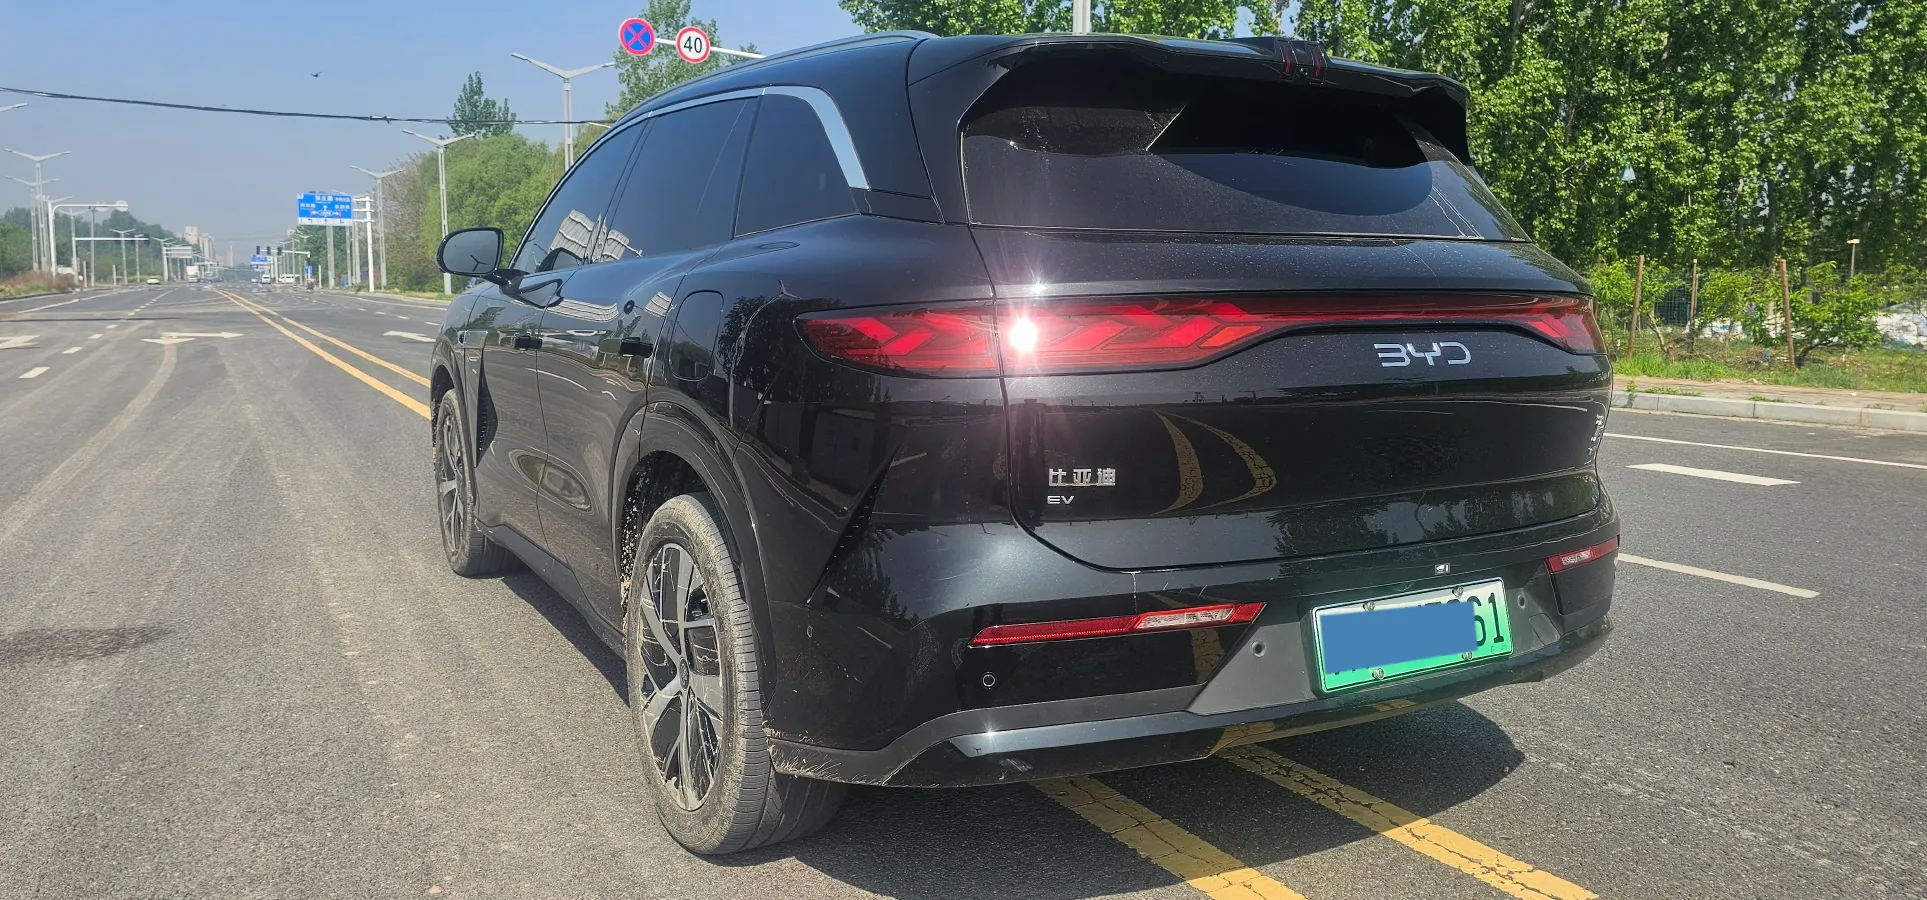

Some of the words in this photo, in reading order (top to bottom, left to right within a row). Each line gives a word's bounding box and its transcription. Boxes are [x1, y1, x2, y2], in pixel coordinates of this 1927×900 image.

[683, 36, 703, 53] 40
[1373, 341, 1472, 367] BYD
[1048, 467, 1116, 487] 比亚迪
[1046, 495, 1075, 505] EV
